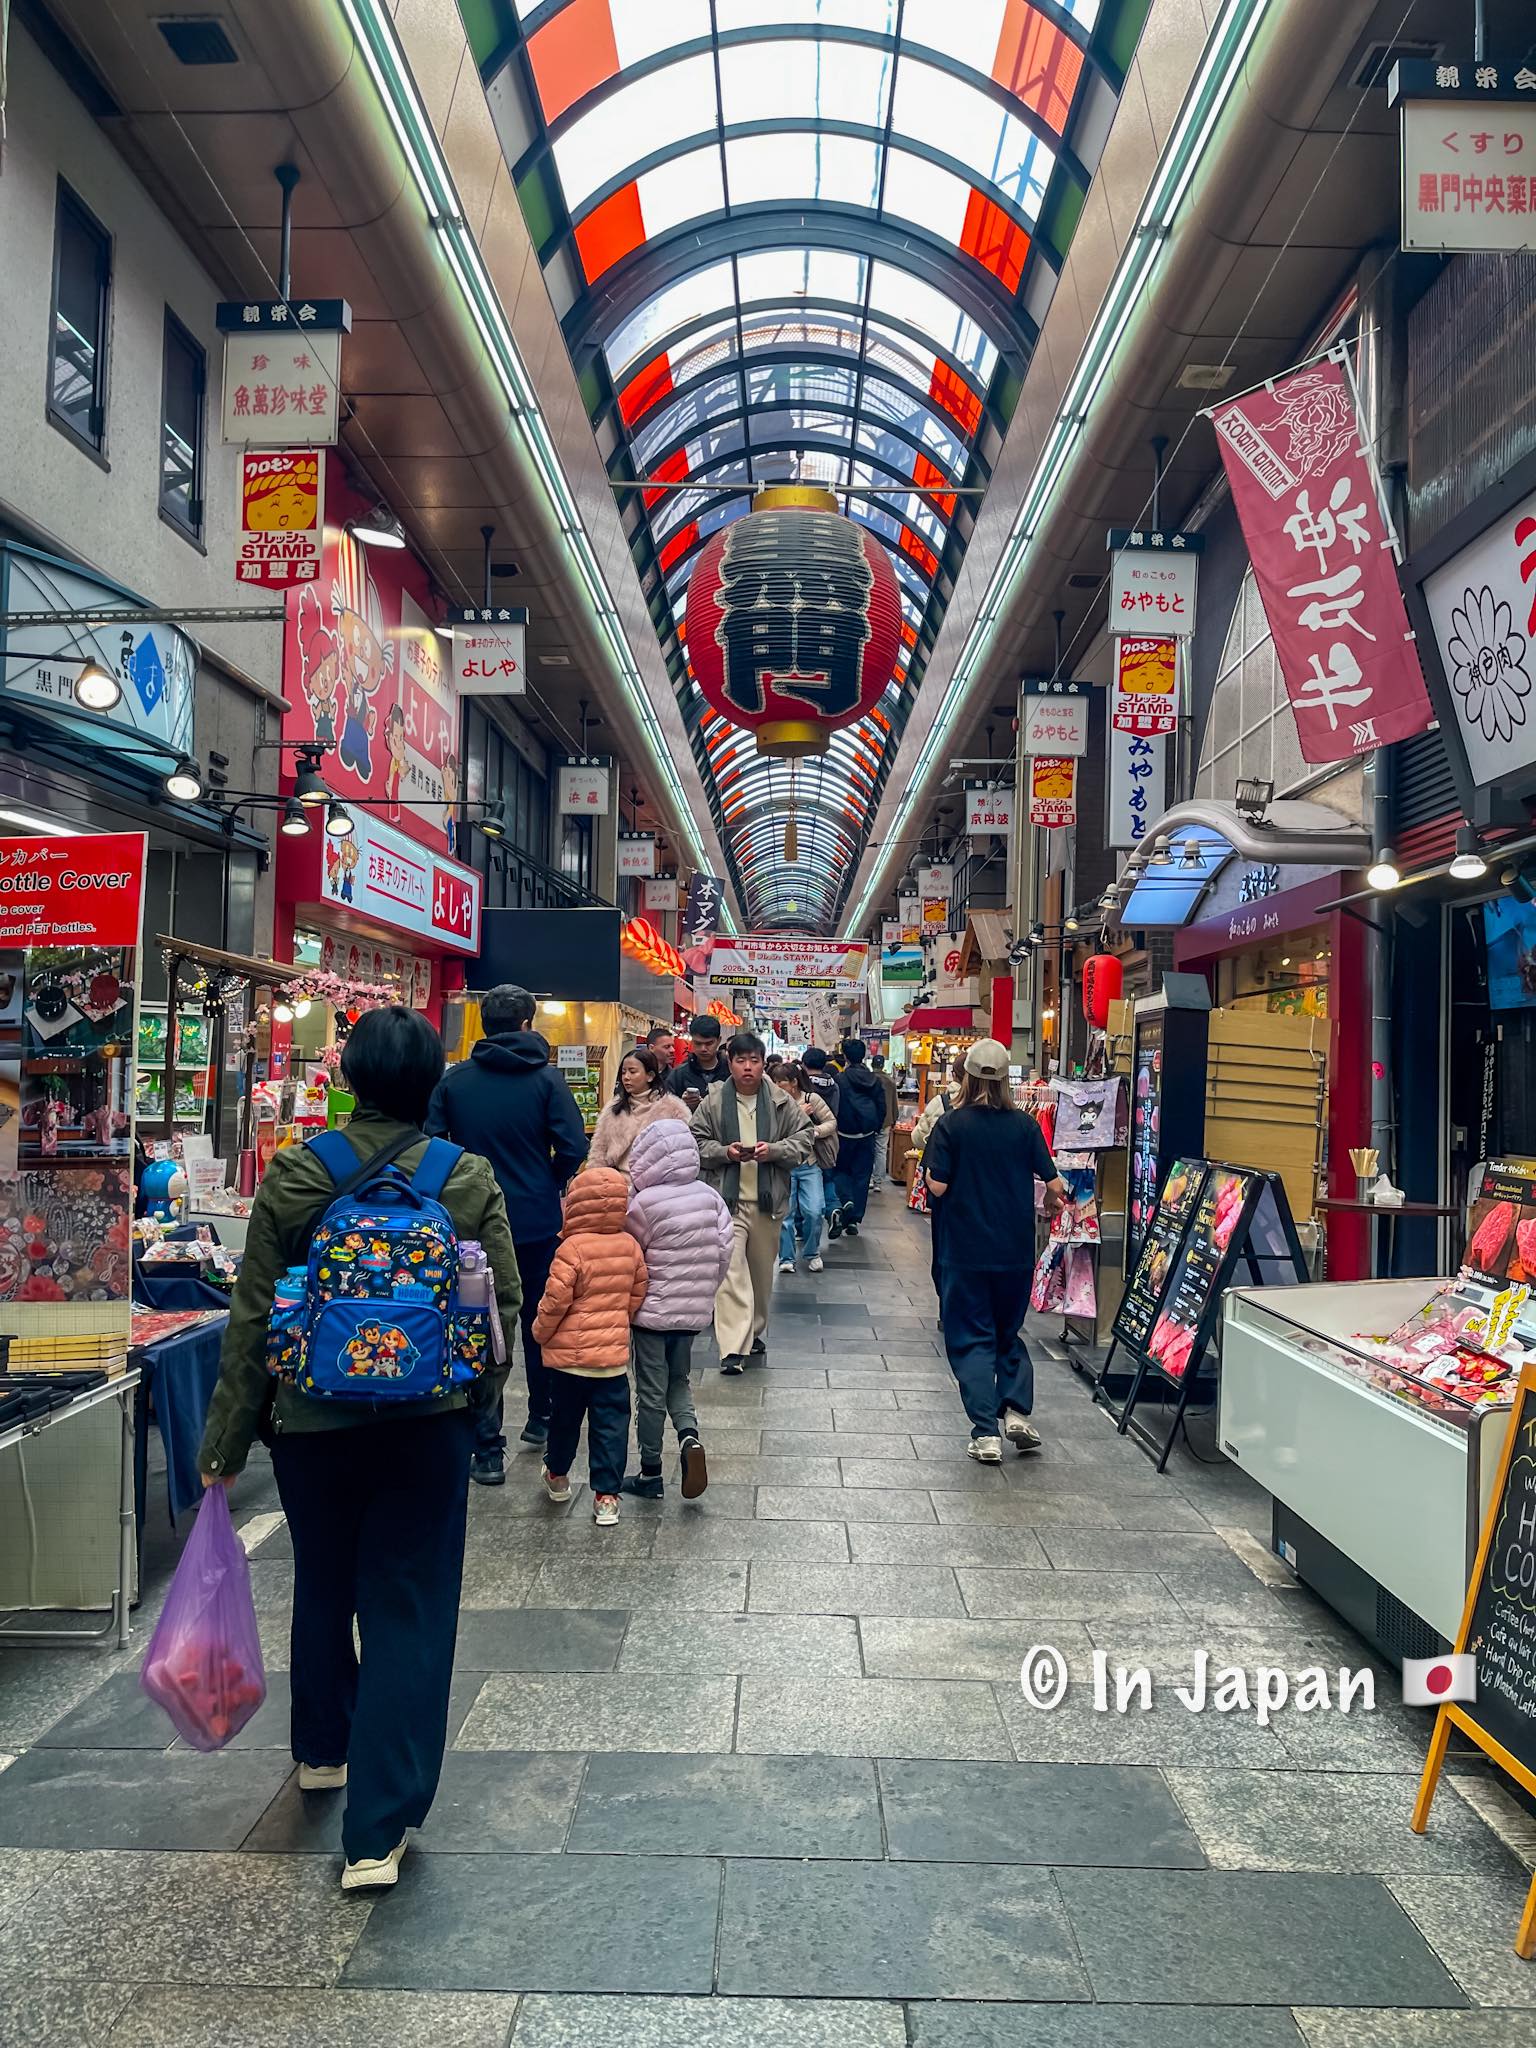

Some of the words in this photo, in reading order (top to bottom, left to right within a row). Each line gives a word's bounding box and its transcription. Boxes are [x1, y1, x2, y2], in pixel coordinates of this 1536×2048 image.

[1441, 132, 1524, 154] くすり
[242, 304, 317, 323] 親栄会
[233, 383, 328, 416] 魚萬珍味堂
[245, 457, 294, 478] クロモン
[248, 531, 308, 544] フレッシュ
[1130, 532, 1186, 548] 親栄会
[241, 543, 316, 559] STAMP
[241, 561, 315, 579] 加盟店
[1131, 570, 1176, 581] 和のこもの
[1120, 591, 1185, 613] みやもと
[463, 609, 511, 621] 親栄会
[465, 638, 512, 649] お菓子のデパート
[1122, 641, 1158, 655] クロモン
[462, 659, 516, 677] よしや
[1122, 693, 1168, 704] フレッシュ
[1117, 702, 1173, 715] STAMP
[405, 687, 450, 767] よしや
[1116, 715, 1173, 730] 加盟店
[1032, 724, 1080, 742] みやもと
[1127, 735, 1154, 840] みやもと
[1032, 804, 1073, 814] STAMP
[1035, 798, 1068, 806] フレッシュ
[1032, 813, 1073, 824] 加盟店
[59, 870, 132, 889] Cover
[368, 853, 425, 902] お菓子のデパート
[11, 905, 45, 915] cover
[433, 876, 473, 932] よしや
[691, 879, 719, 946] 本マグロ
[1, 926, 23, 936] and
[26, 923, 50, 935] PET
[53, 921, 97, 934] bottles.
[783, 953, 815, 962] STAMP
[1522, 1418, 1536, 1448] T
[1485, 1642, 1508, 1669] Hand
[1507, 1656, 1524, 1685] Drip
[1493, 1671, 1519, 1706] Matcha
